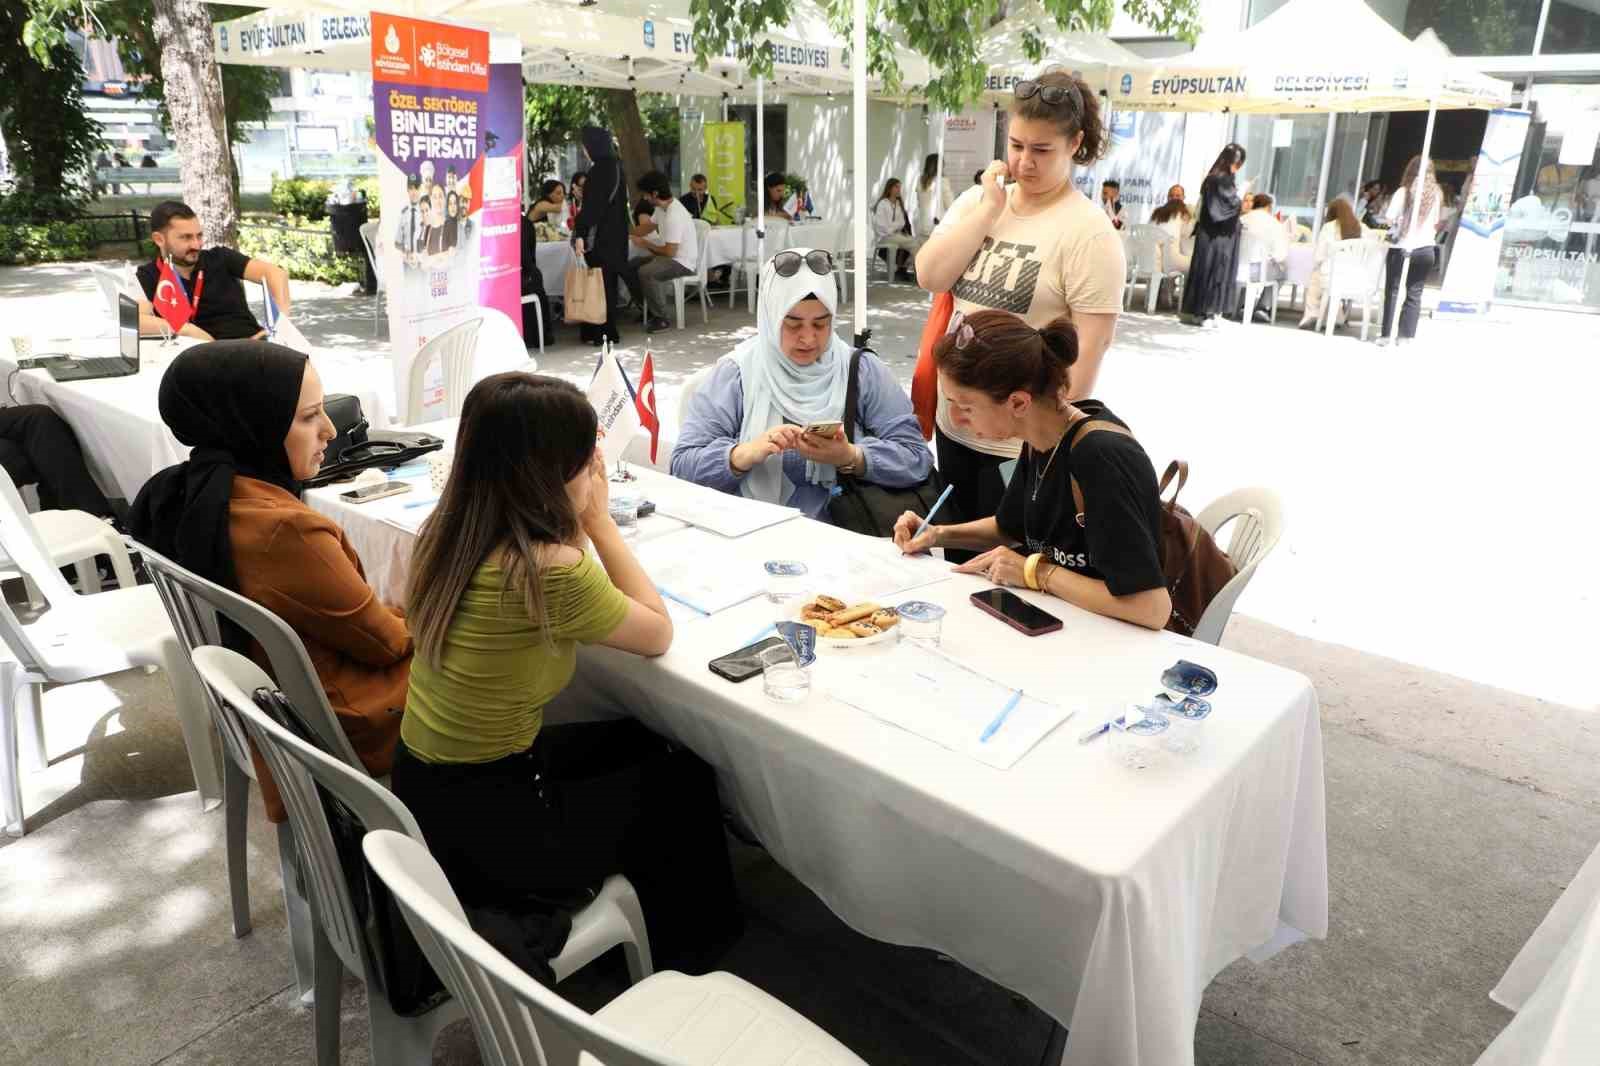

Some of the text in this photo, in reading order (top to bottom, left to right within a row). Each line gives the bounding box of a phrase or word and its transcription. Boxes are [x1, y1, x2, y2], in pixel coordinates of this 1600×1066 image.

[771, 43, 829, 69] BELEDİYESİ
[1152, 75, 1247, 95] EYÜPSULTAN
[390, 91, 478, 113] ÖZEL SEKTÖRDE
[391, 109, 478, 137] BİNLERCE
[392, 134, 477, 162] İŞ FIRSATI
[1053, 546, 1087, 568] BOSS
